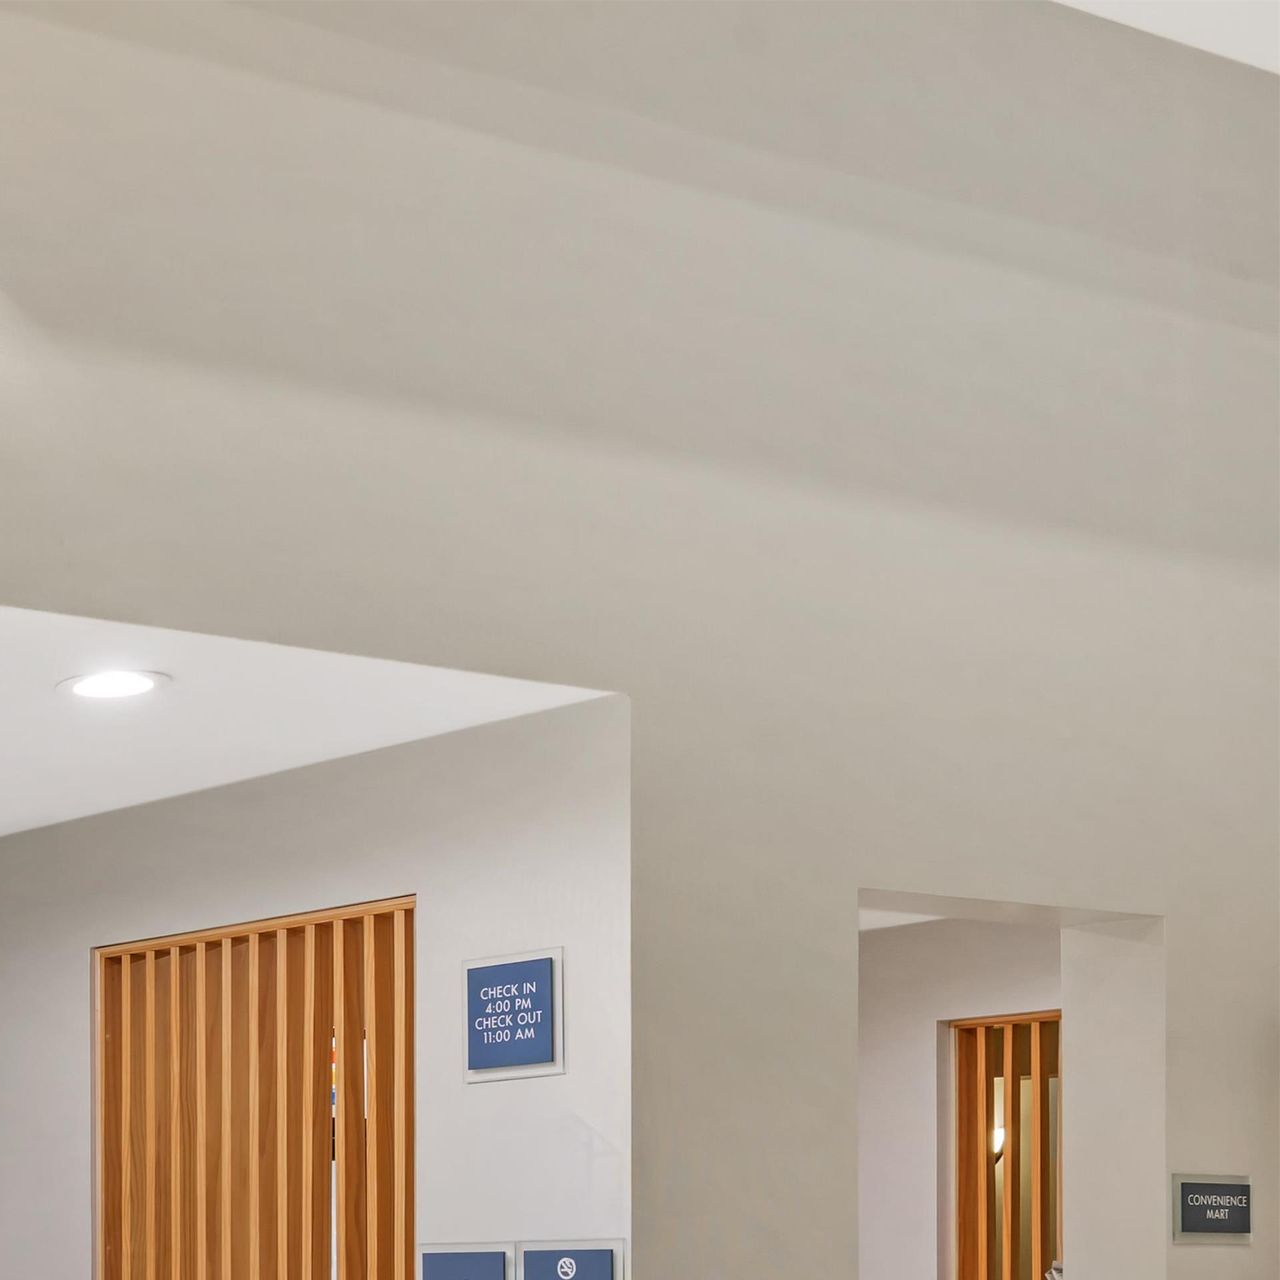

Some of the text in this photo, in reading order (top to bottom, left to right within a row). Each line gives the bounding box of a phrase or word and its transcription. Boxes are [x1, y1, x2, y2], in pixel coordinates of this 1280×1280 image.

[480, 981, 536, 1000] CHECK IN
[485, 997, 532, 1014] 4:00 PM
[474, 1010, 543, 1031] CHECK OUT
[483, 1027, 535, 1045] 11:00 AM
[1187, 1194, 1248, 1207] CONVENIENCE
[1206, 1208, 1230, 1220] MART
